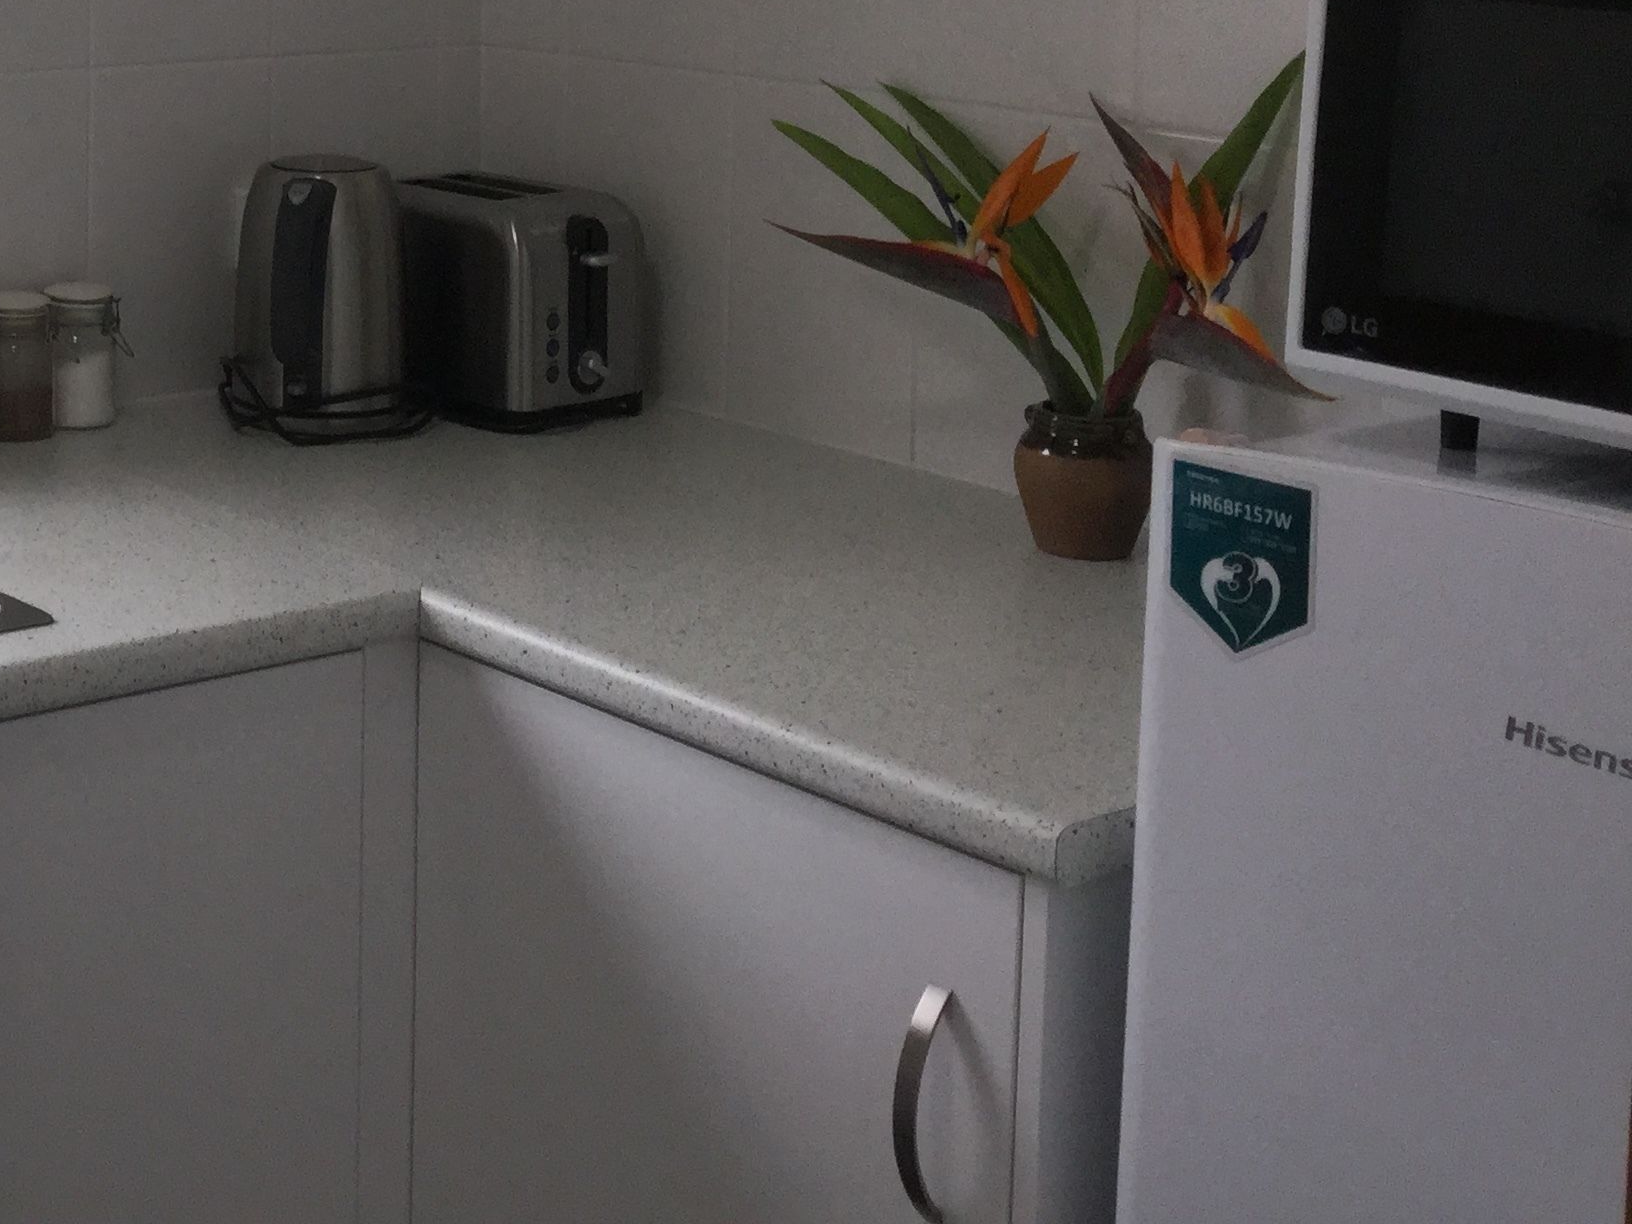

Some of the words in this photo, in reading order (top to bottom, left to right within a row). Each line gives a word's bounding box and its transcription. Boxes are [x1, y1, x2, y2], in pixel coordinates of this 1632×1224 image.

[1350, 315, 1378, 338] LG
[1189, 491, 1292, 529] HR6BF157W
[1215, 551, 1255, 603] 3
[1505, 716, 1632, 780] Hisens
